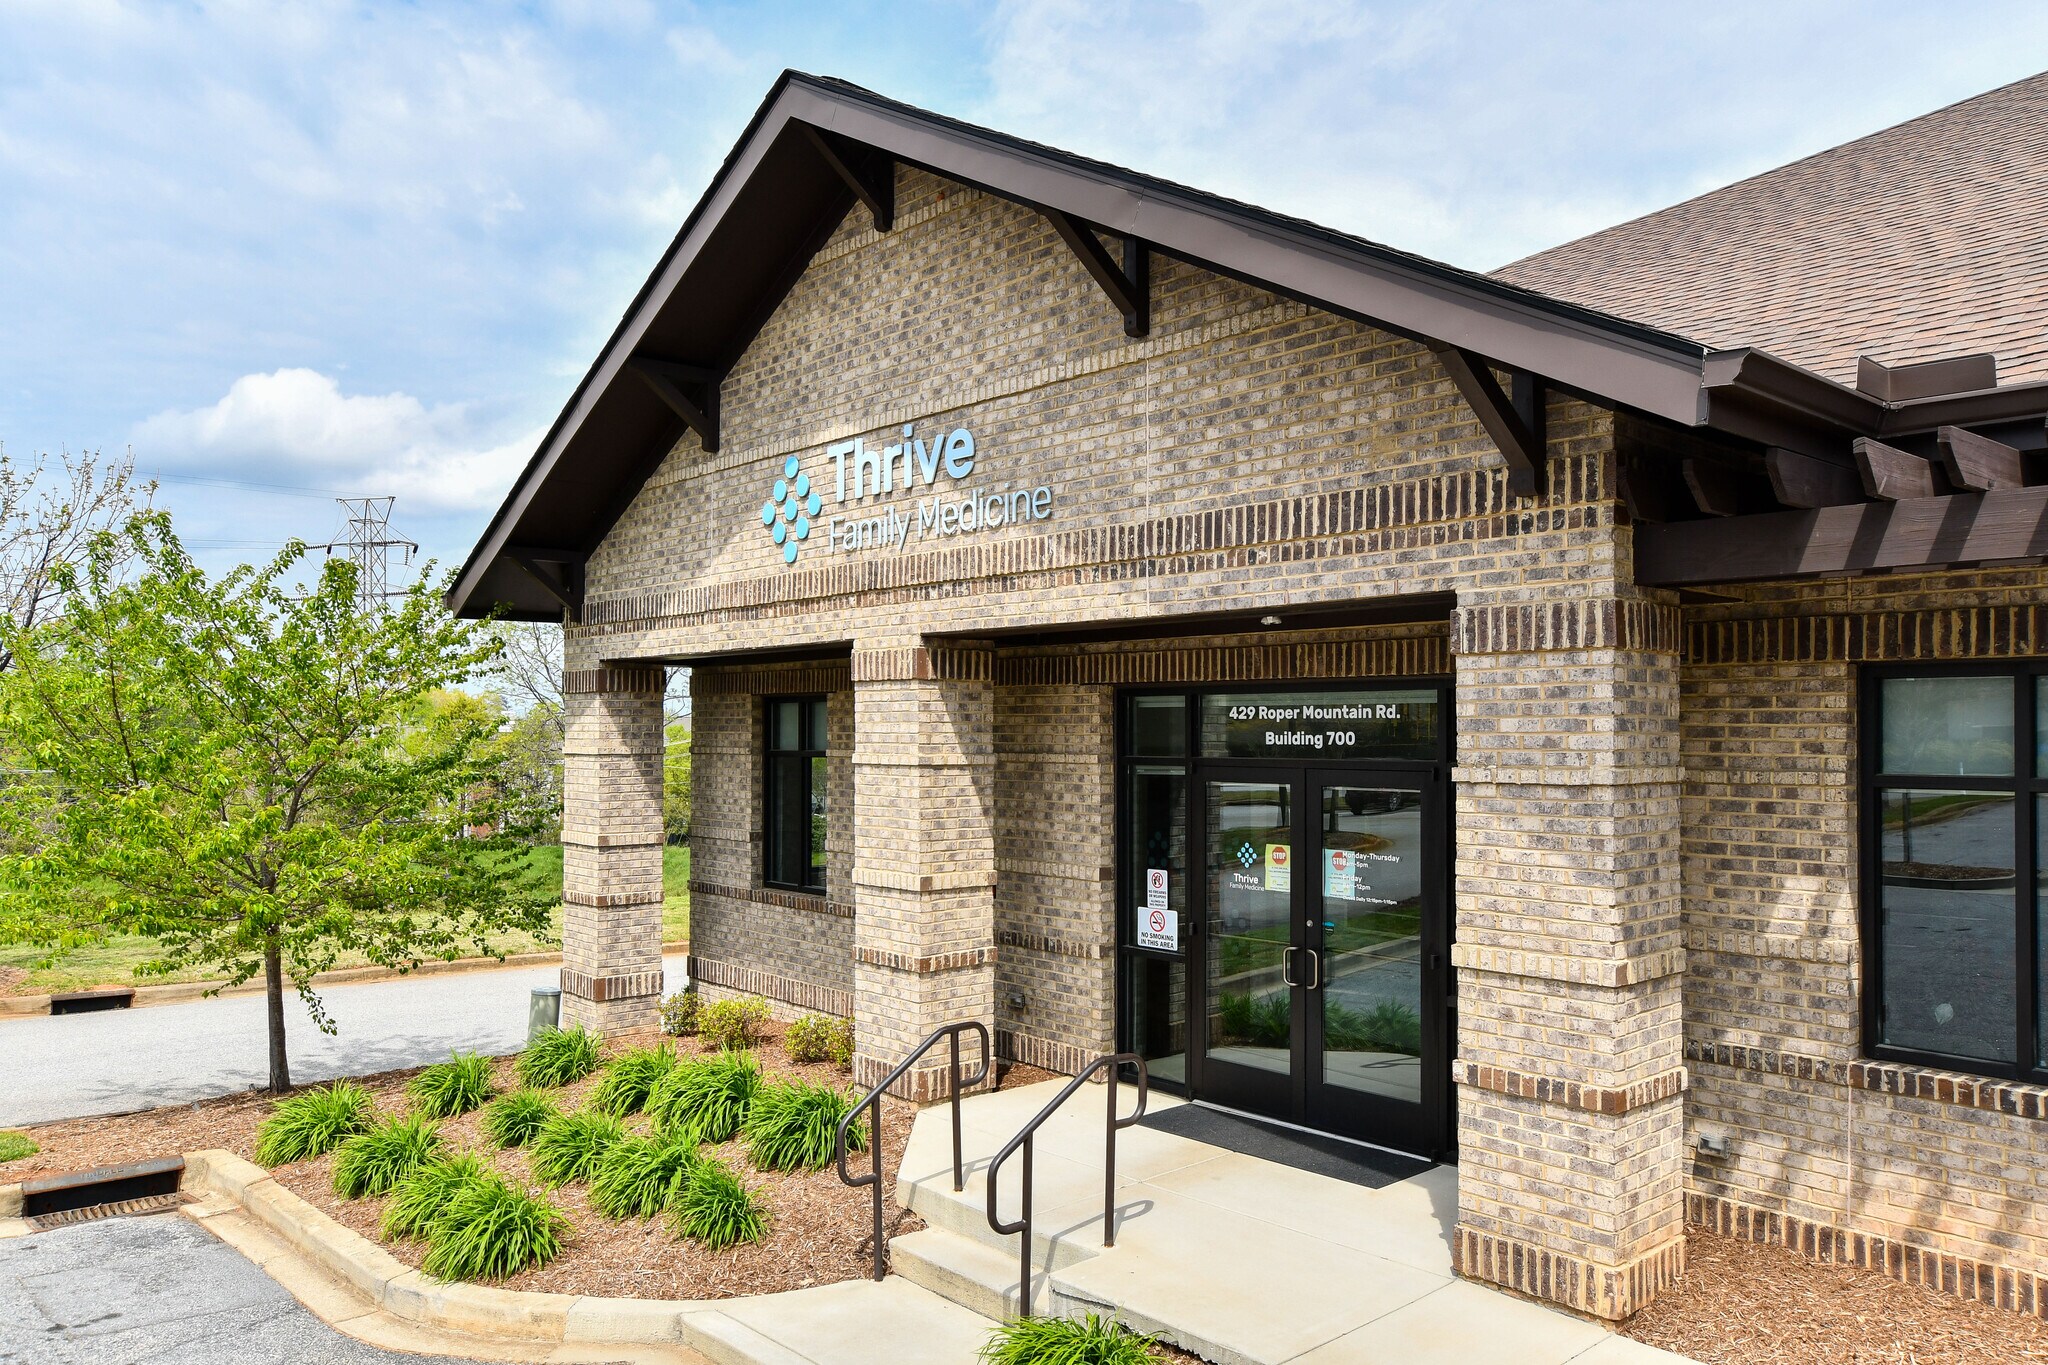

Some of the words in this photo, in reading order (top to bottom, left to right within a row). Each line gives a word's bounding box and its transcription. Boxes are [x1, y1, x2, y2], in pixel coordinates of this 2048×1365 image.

[827, 423, 976, 503] Thrive
[829, 504, 912, 553] Family
[917, 482, 1052, 538] Medicine
[1229, 705, 1255, 720] 429
[1258, 705, 1300, 722] Roper
[1302, 704, 1372, 719] Mountain
[1375, 704, 1401, 719] Rd.
[1265, 731, 1323, 749] Building
[1326, 731, 1356, 746] 700
[1272, 851, 1286, 860] STOP
[1342, 851, 1400, 863] Monday-Thursday
[1233, 873, 1258, 884] Thrive
[1230, 882, 1244, 890] Family
[1149, 932, 1174, 941] SMOKING
[1160, 941, 1174, 949] AREA
